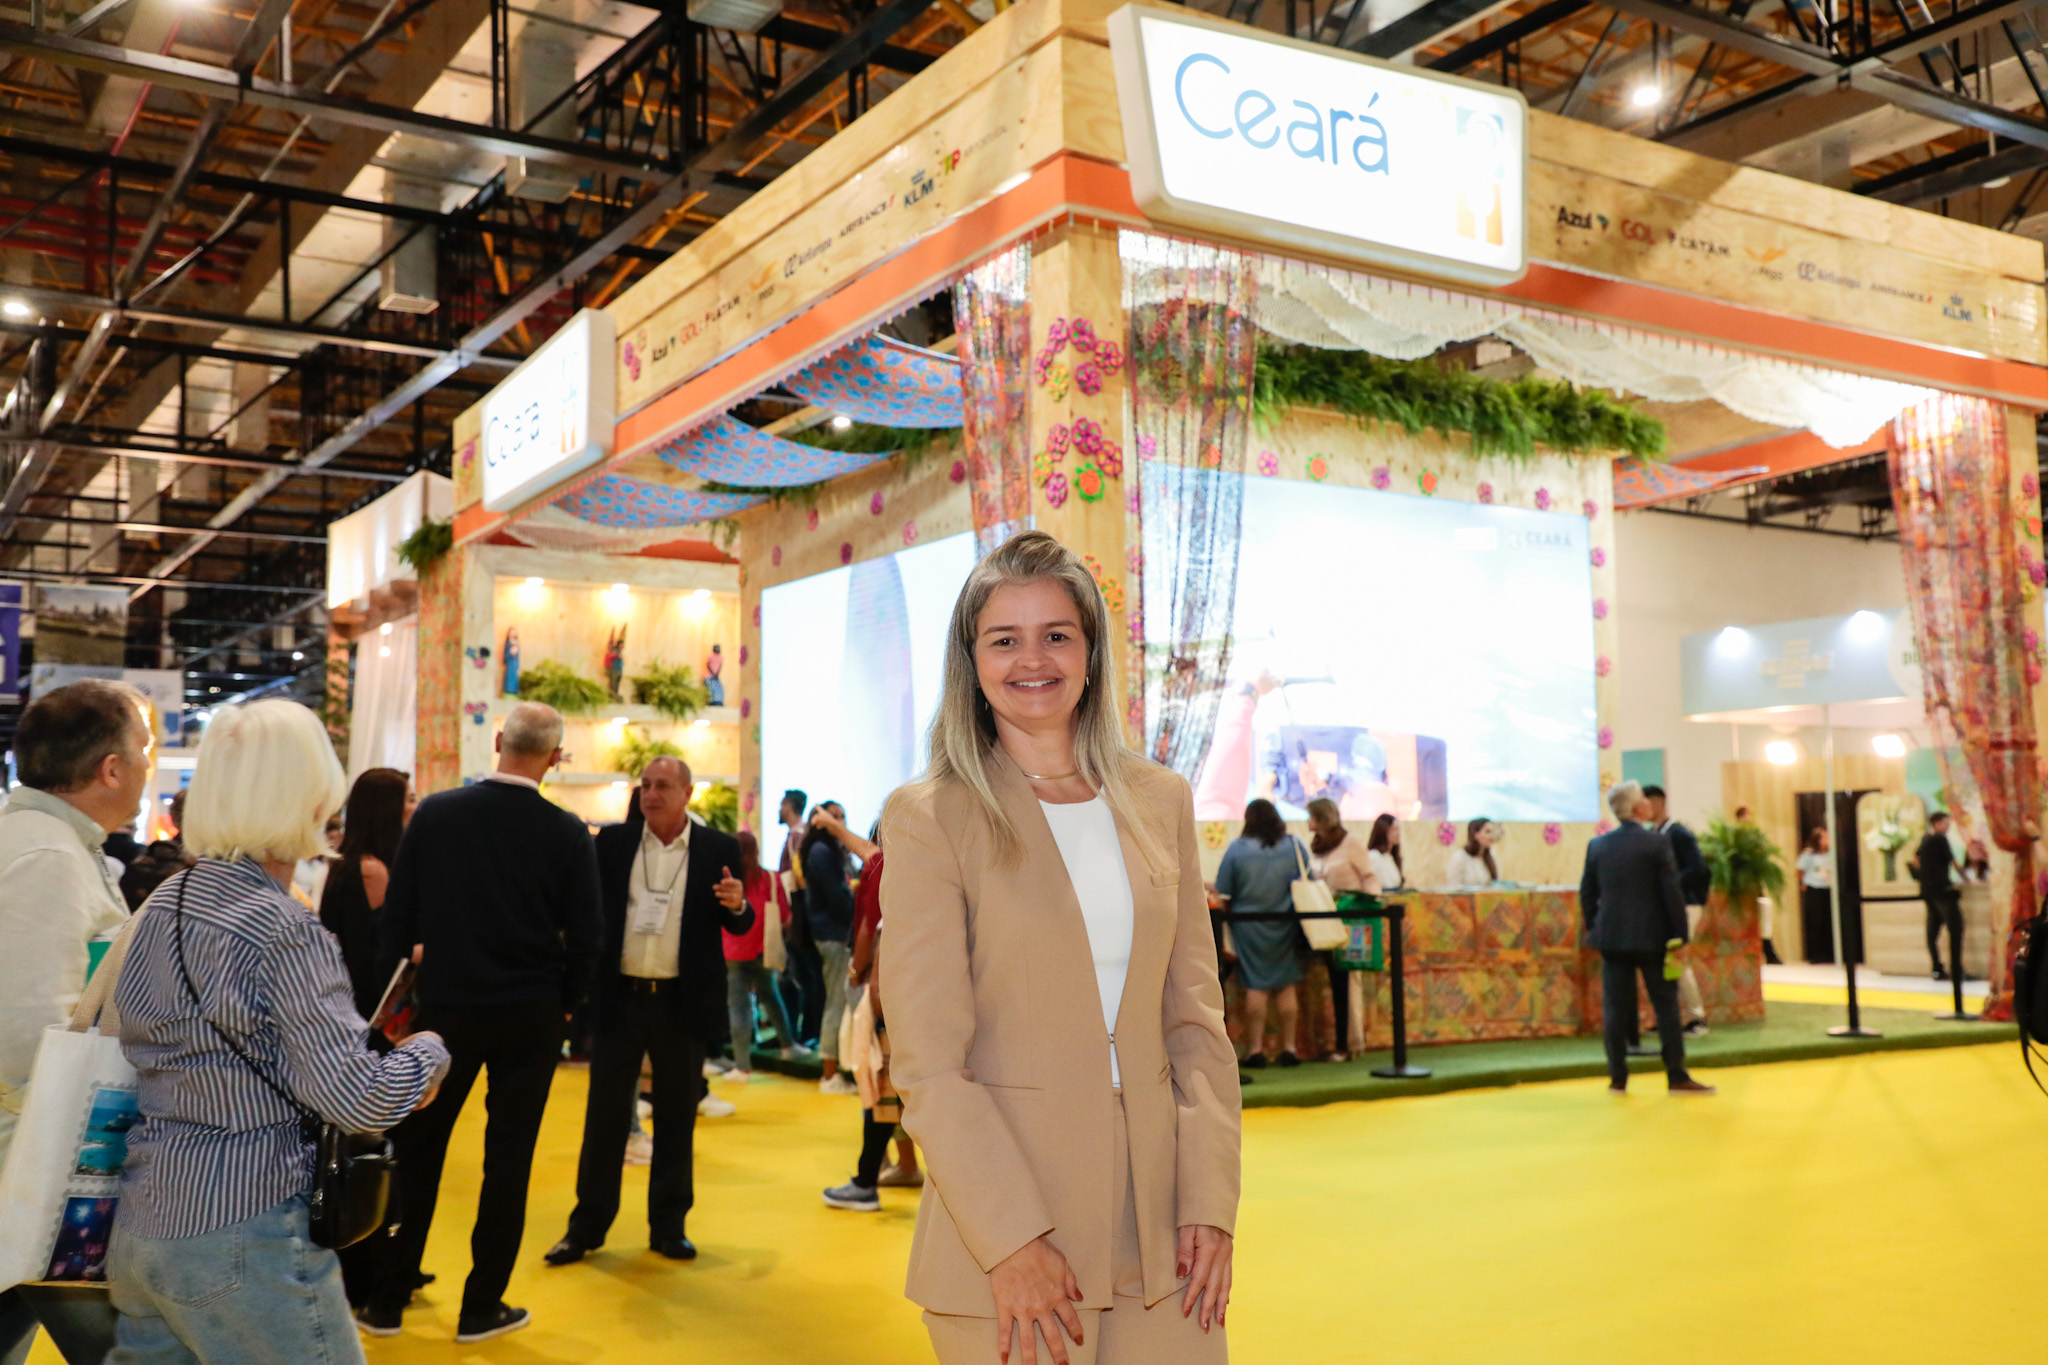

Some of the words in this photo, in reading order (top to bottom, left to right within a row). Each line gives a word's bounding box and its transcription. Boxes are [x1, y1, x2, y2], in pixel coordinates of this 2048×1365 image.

[1174, 52, 1390, 176] Ceará
[904, 177, 934, 208] KLM
[1557, 206, 1592, 229] Azul
[1620, 218, 1656, 245] GOL
[1942, 305, 1973, 323] KLM
